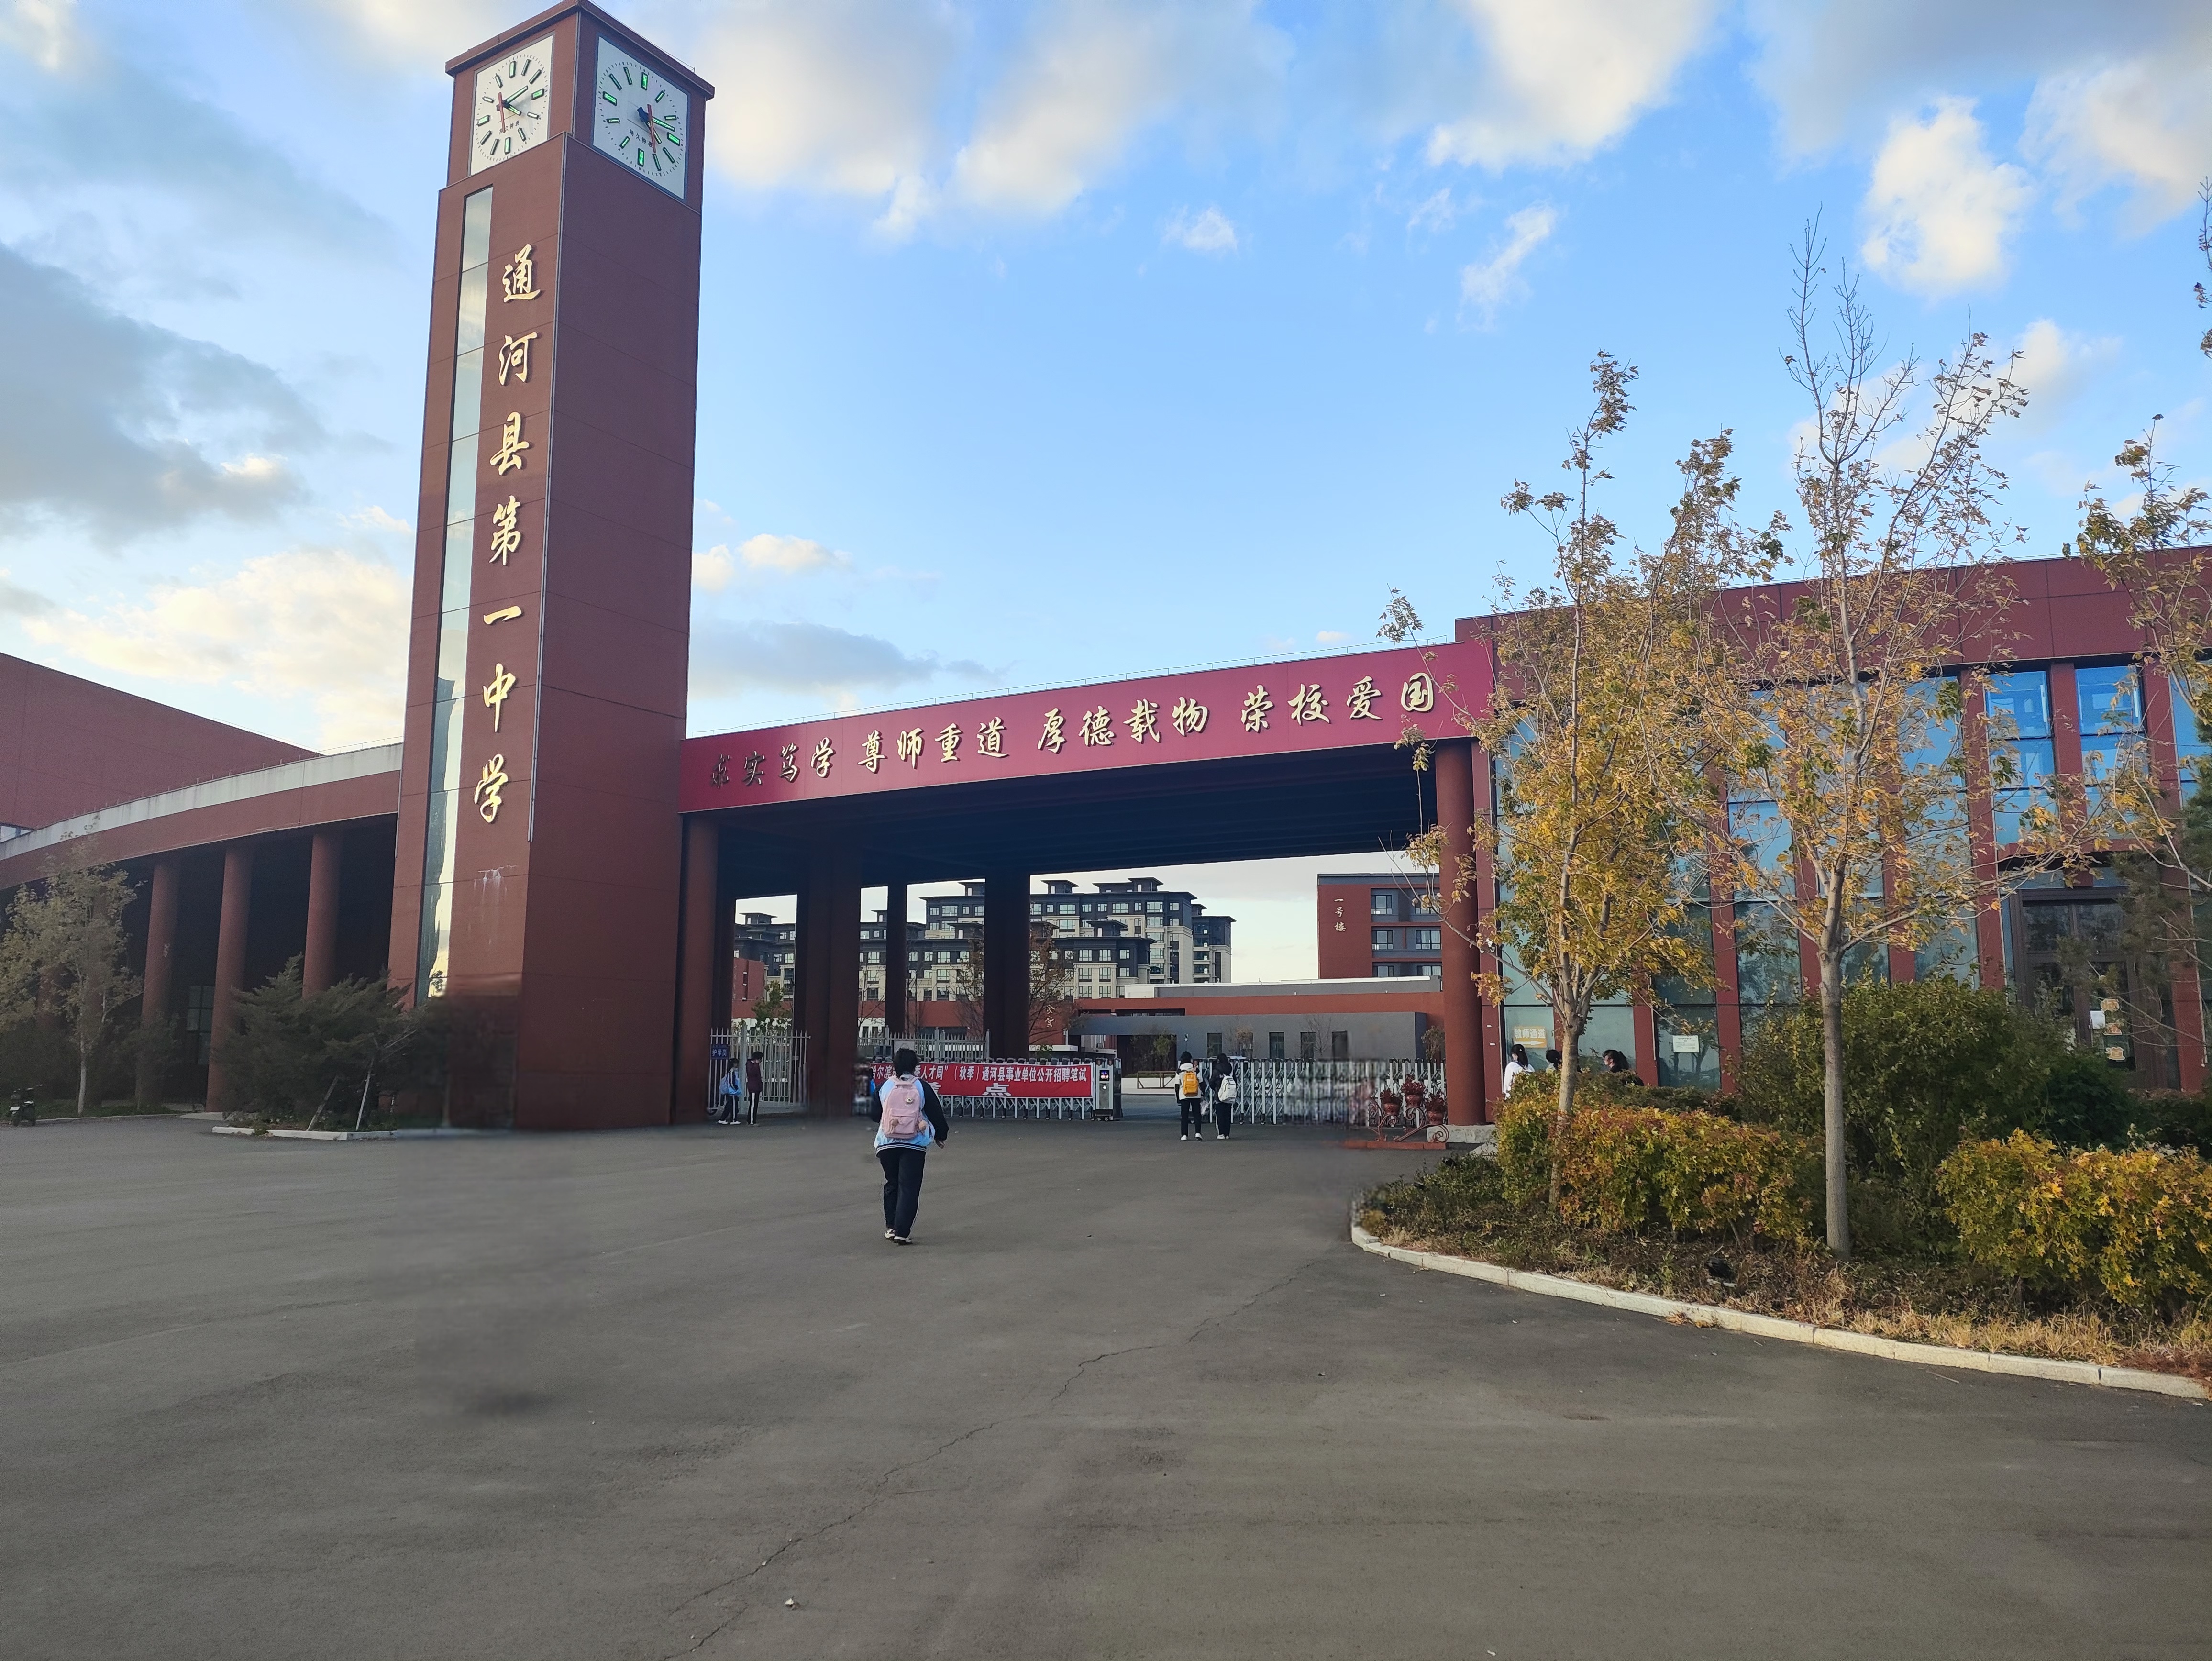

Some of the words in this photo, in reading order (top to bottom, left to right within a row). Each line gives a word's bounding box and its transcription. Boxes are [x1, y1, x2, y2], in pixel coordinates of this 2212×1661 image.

[474, 244, 541, 823] 通河县第一中学
[710, 737, 835, 788] 求实笃学
[858, 716, 1009, 773] 尊师重道
[1038, 696, 1209, 753] 厚德载物
[1241, 672, 1434, 733] 荣校爱国
[1514, 1028, 1546, 1039] 教师通道
[982, 1083, 1012, 1096] 点
